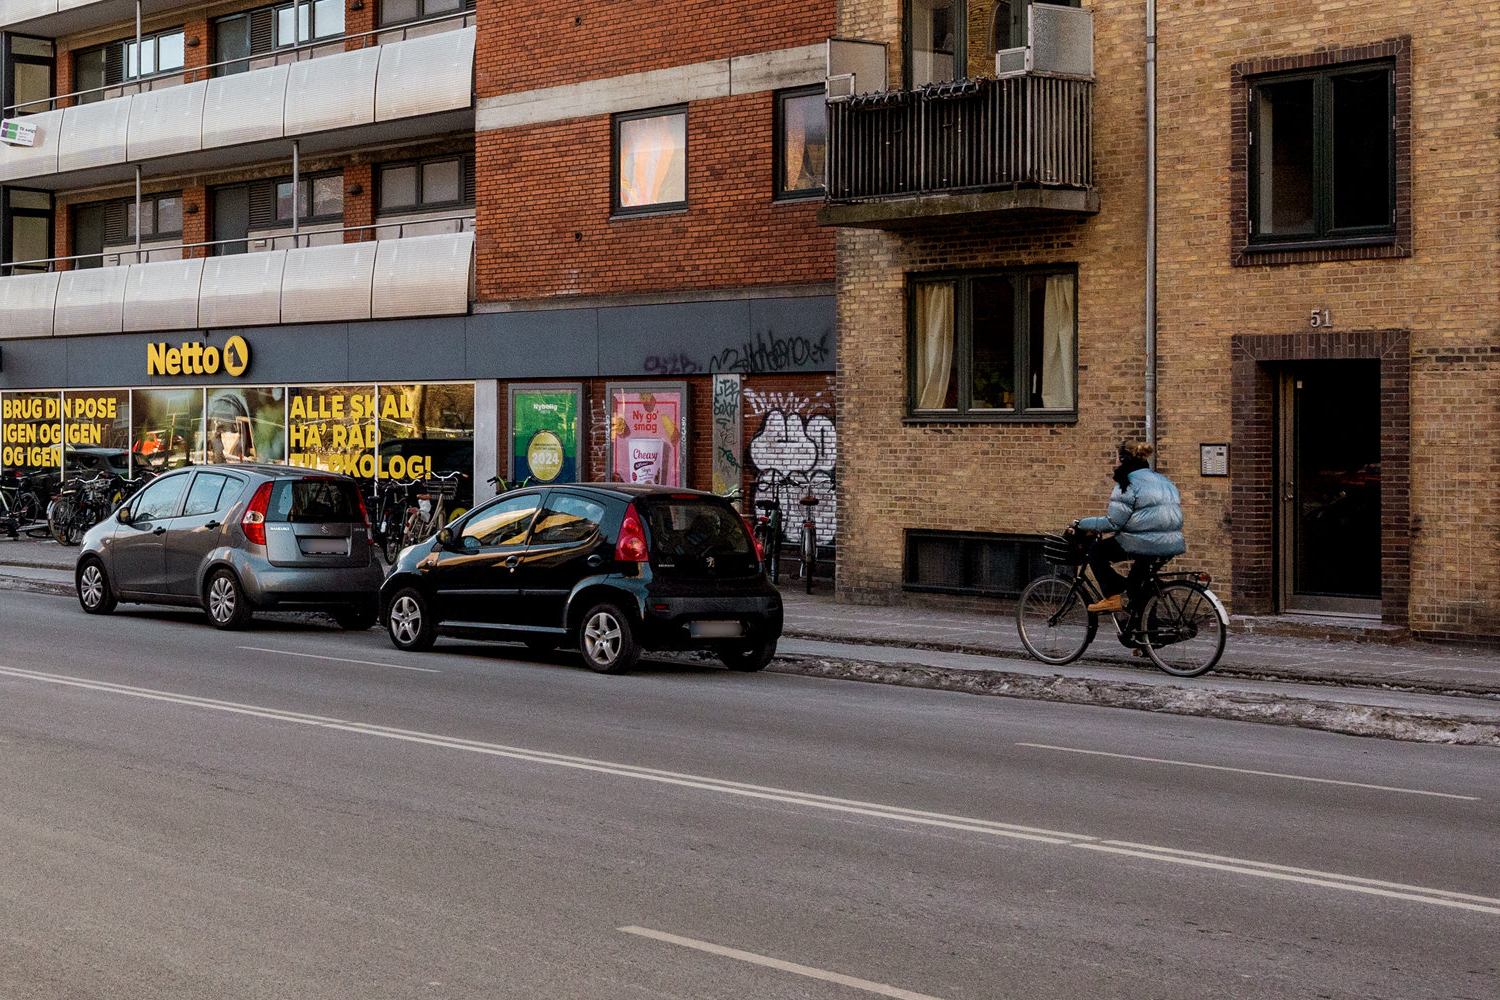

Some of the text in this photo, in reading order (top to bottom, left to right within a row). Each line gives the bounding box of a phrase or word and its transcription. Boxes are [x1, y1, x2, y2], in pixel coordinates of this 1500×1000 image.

[1310, 309, 1332, 327] 51
[146, 342, 219, 375] Netto
[3, 398, 116, 419] BRUG DIN POSE
[289, 394, 413, 418] ALLE SKAL
[533, 403, 558, 411] Nybolig
[632, 410, 659, 423] Ny go'
[3, 423, 101, 443] IGEN OG IGEN
[289, 416, 382, 448] HA' RÅD
[634, 423, 657, 433] smag
[3, 446, 61, 467] OG IGEN
[531, 452, 560, 465] 2024
[633, 449, 658, 461] Cheasy
